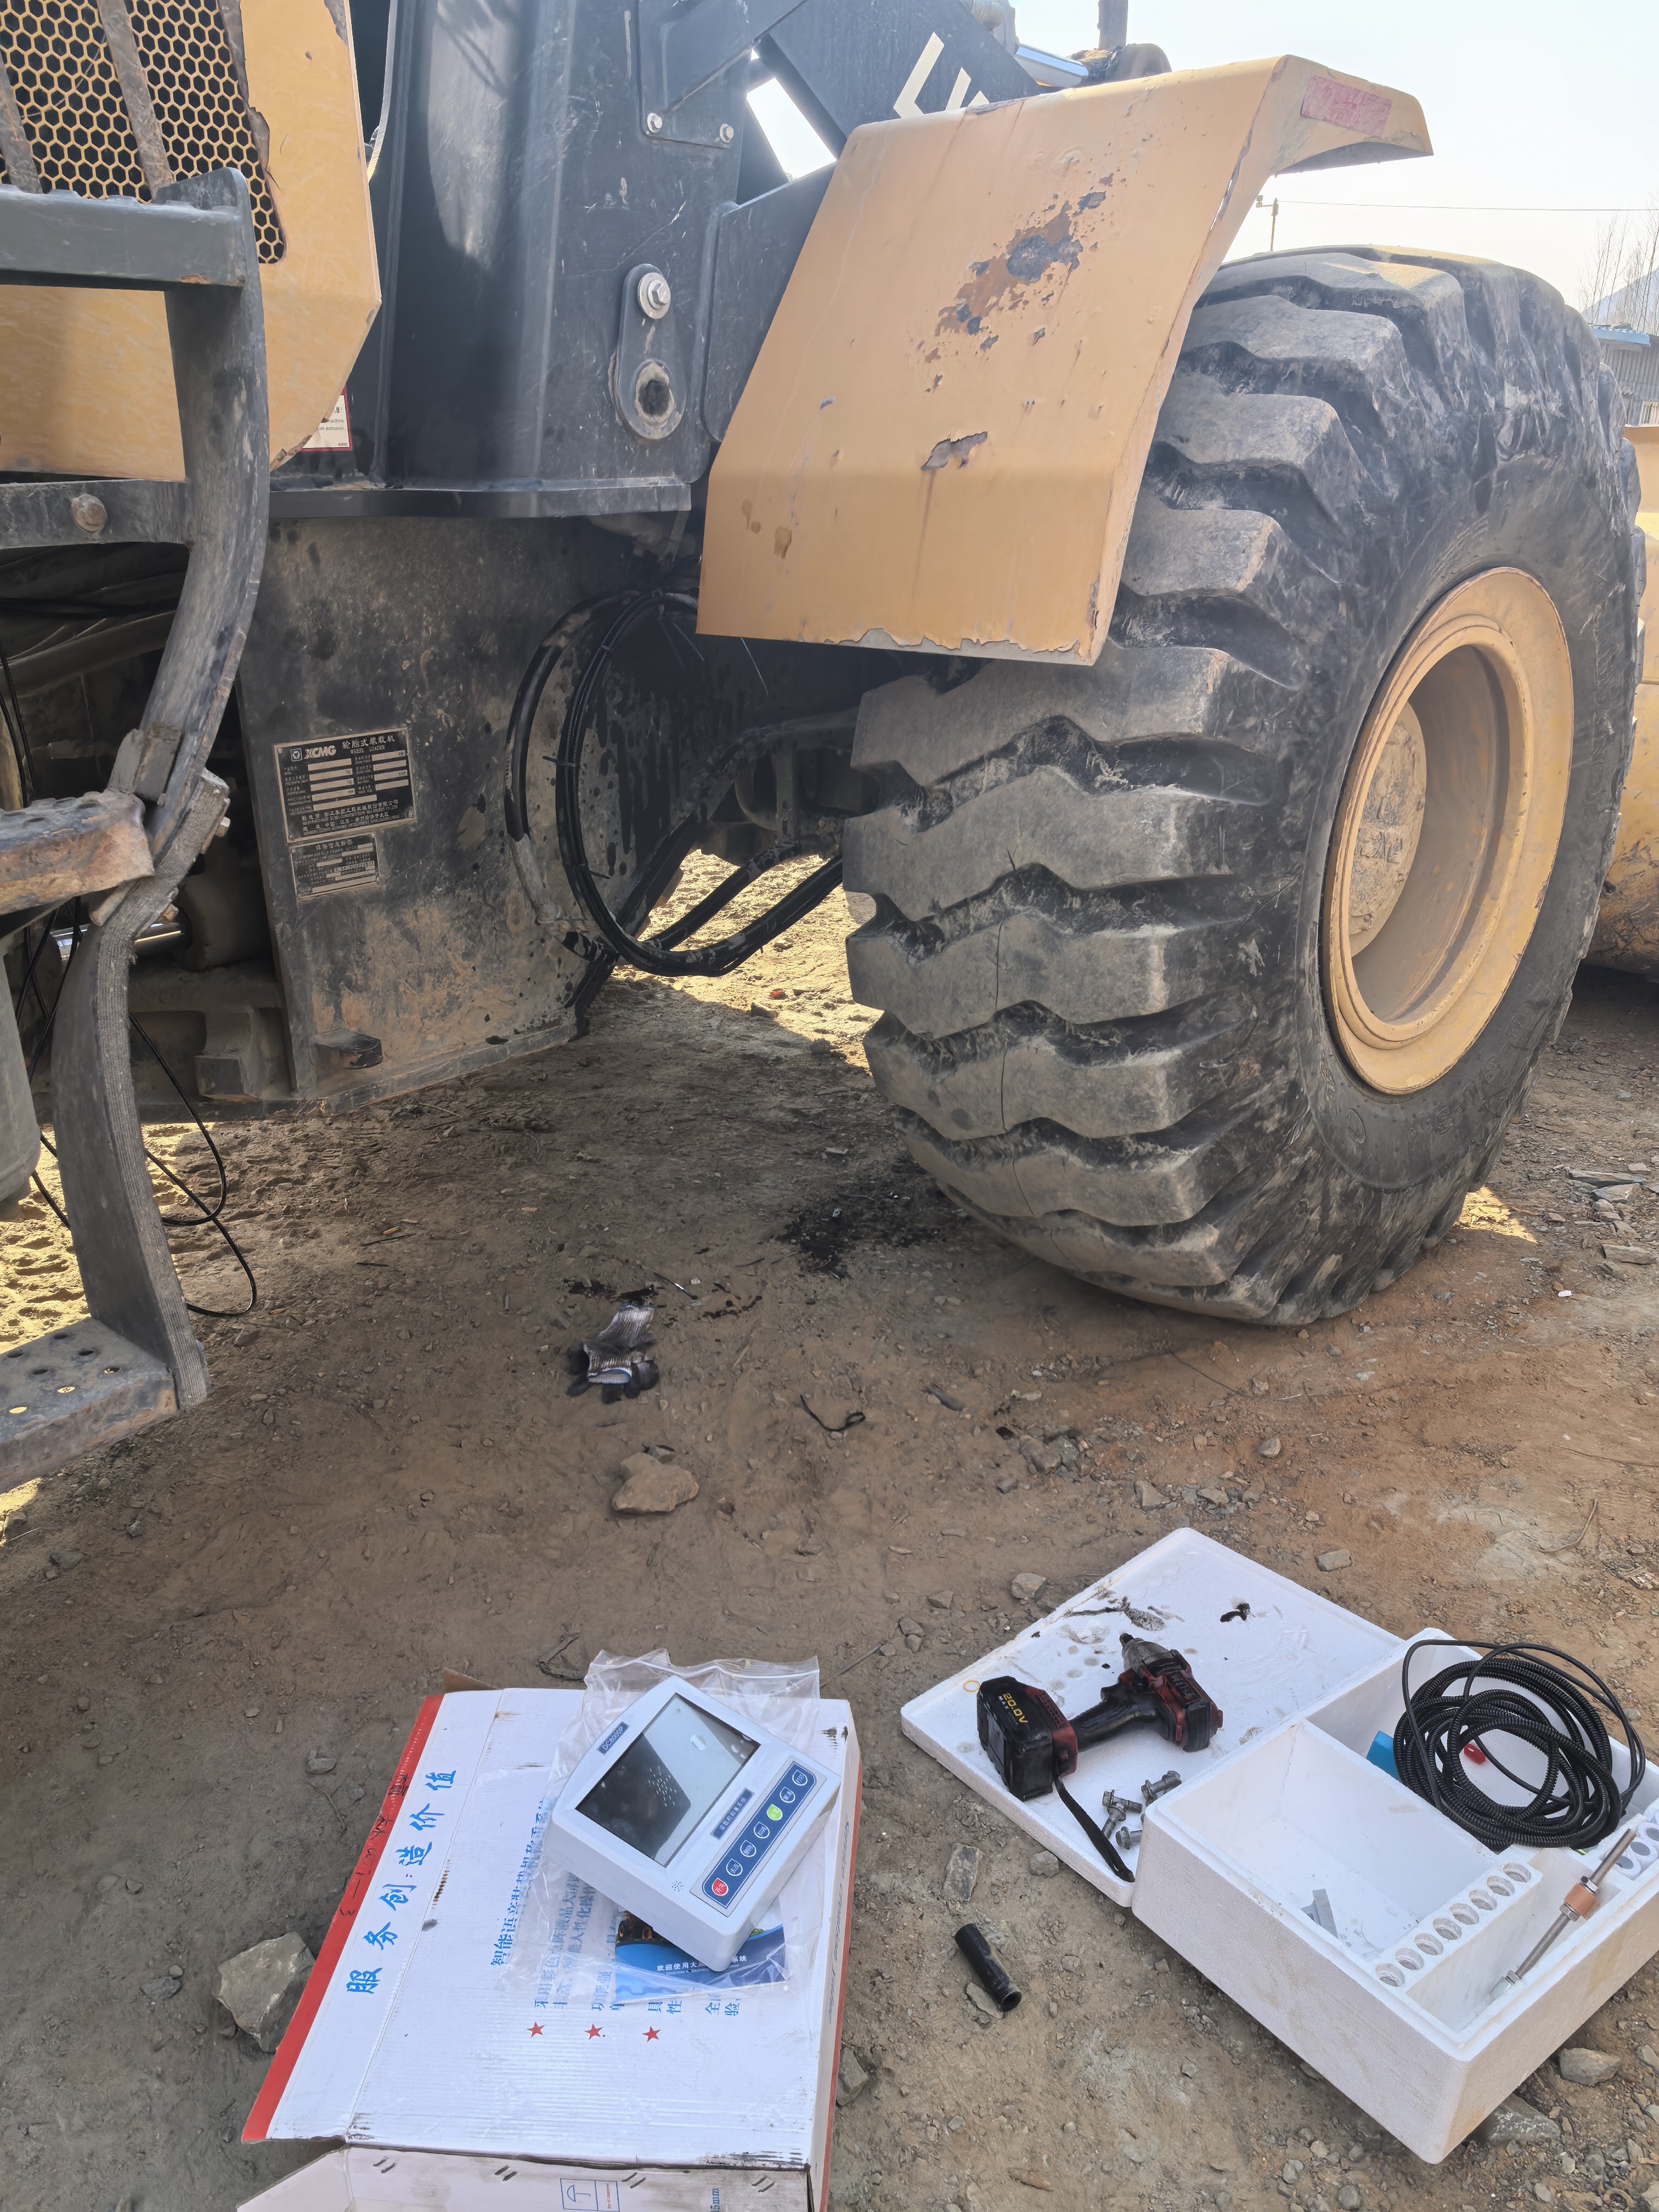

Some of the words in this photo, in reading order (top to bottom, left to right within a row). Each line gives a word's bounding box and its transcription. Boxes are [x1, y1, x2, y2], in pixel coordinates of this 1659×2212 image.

[342, 734, 395, 750] 轮胎式装载机
[304, 745, 336, 760] XCMG
[998, 1695, 1009, 1710] MAX
[1002, 1692, 1028, 1723] 20.0V
[602, 1725, 623, 1750] DC8000P
[346, 1770, 457, 1994] 服务创造价值
